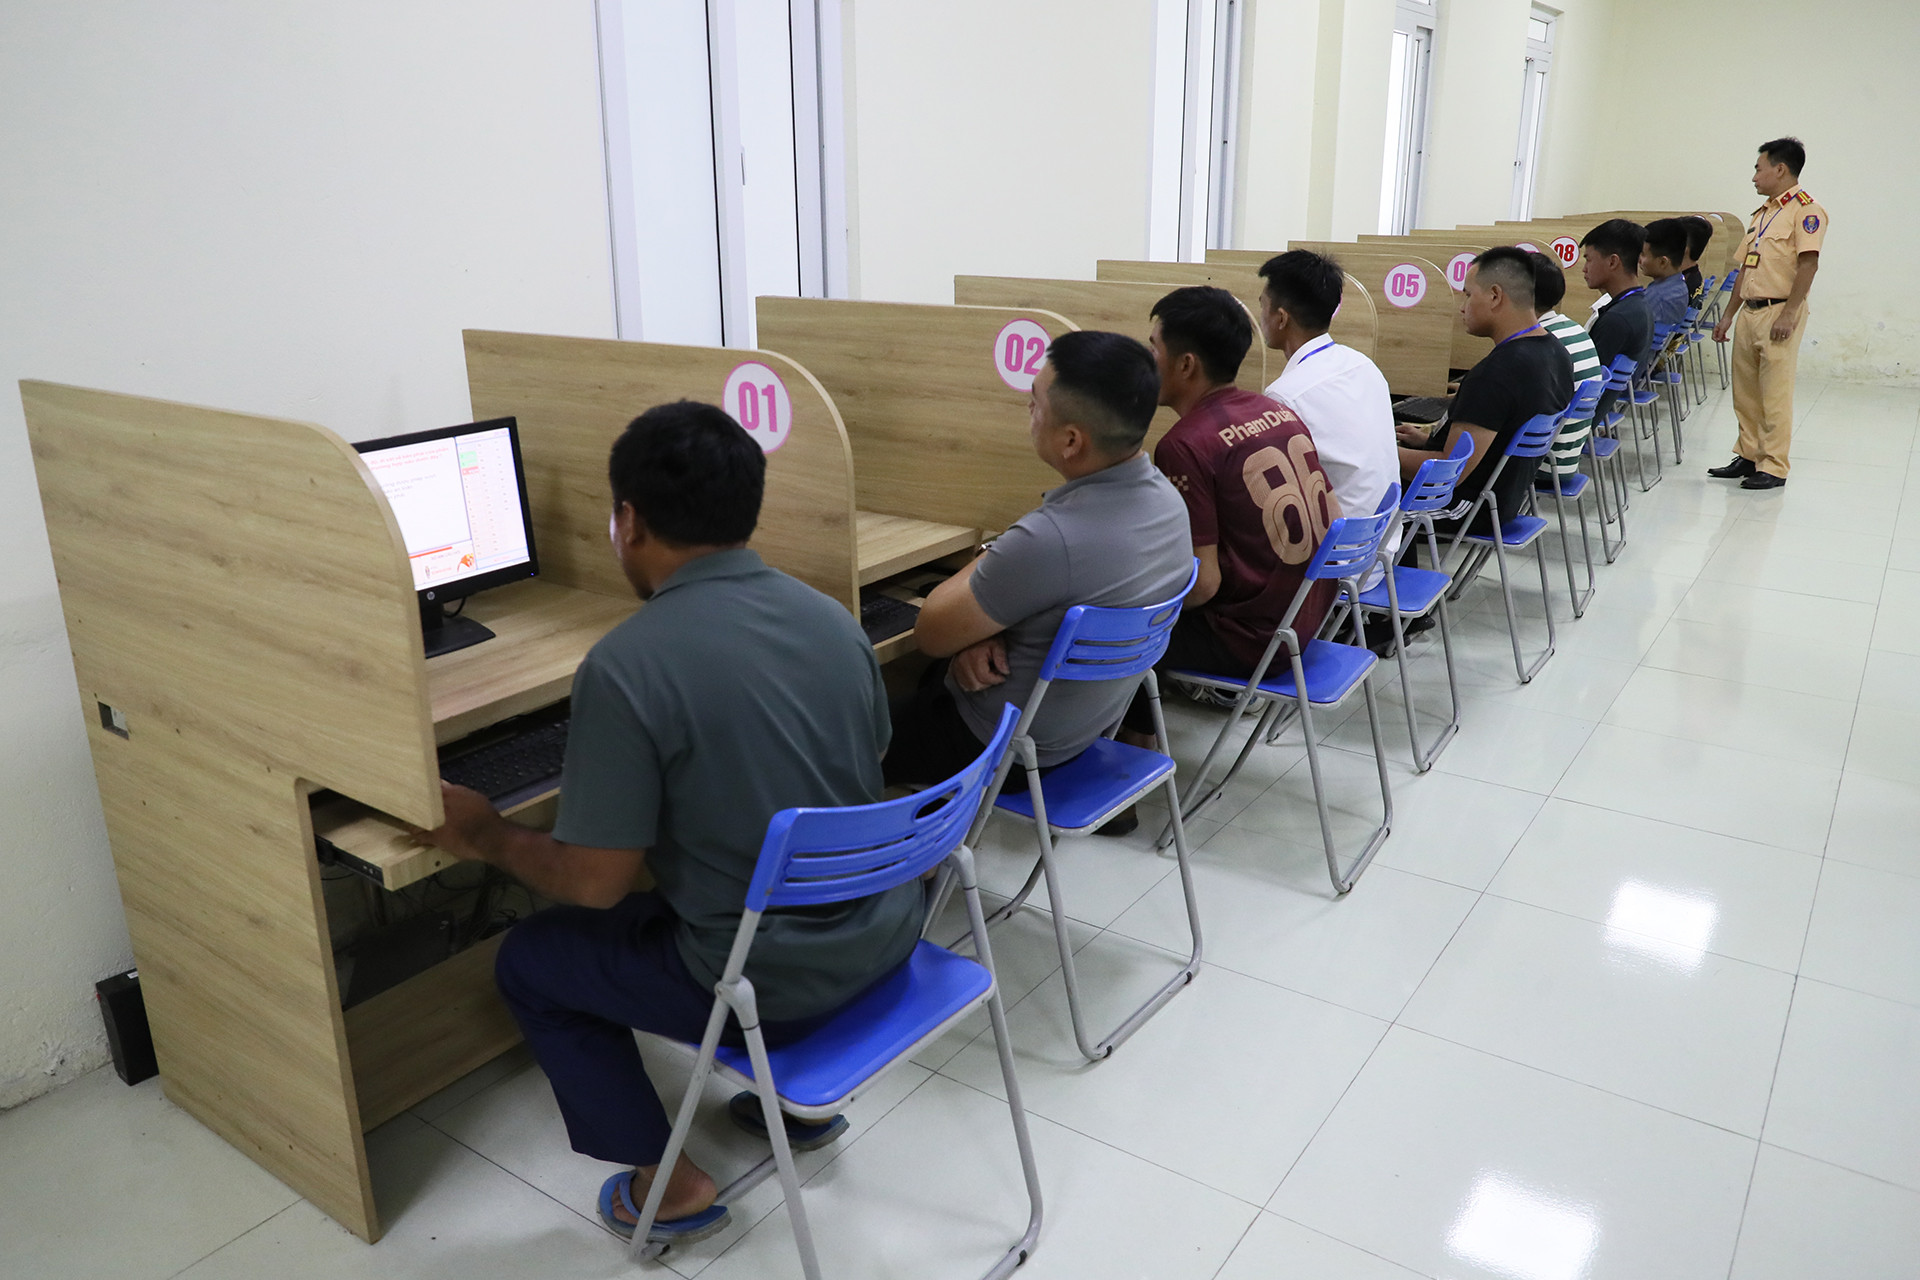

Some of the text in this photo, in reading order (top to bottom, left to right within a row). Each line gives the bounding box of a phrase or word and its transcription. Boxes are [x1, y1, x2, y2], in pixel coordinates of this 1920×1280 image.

[1555, 243, 1575, 262] 08
[1391, 272, 1420, 298] 05
[1453, 261, 1473, 282] 0
[1005, 333, 1045, 376] 02
[738, 381, 778, 433] 01
[1218, 416, 1271, 447] Phạm
[1242, 433, 1344, 565] 86
